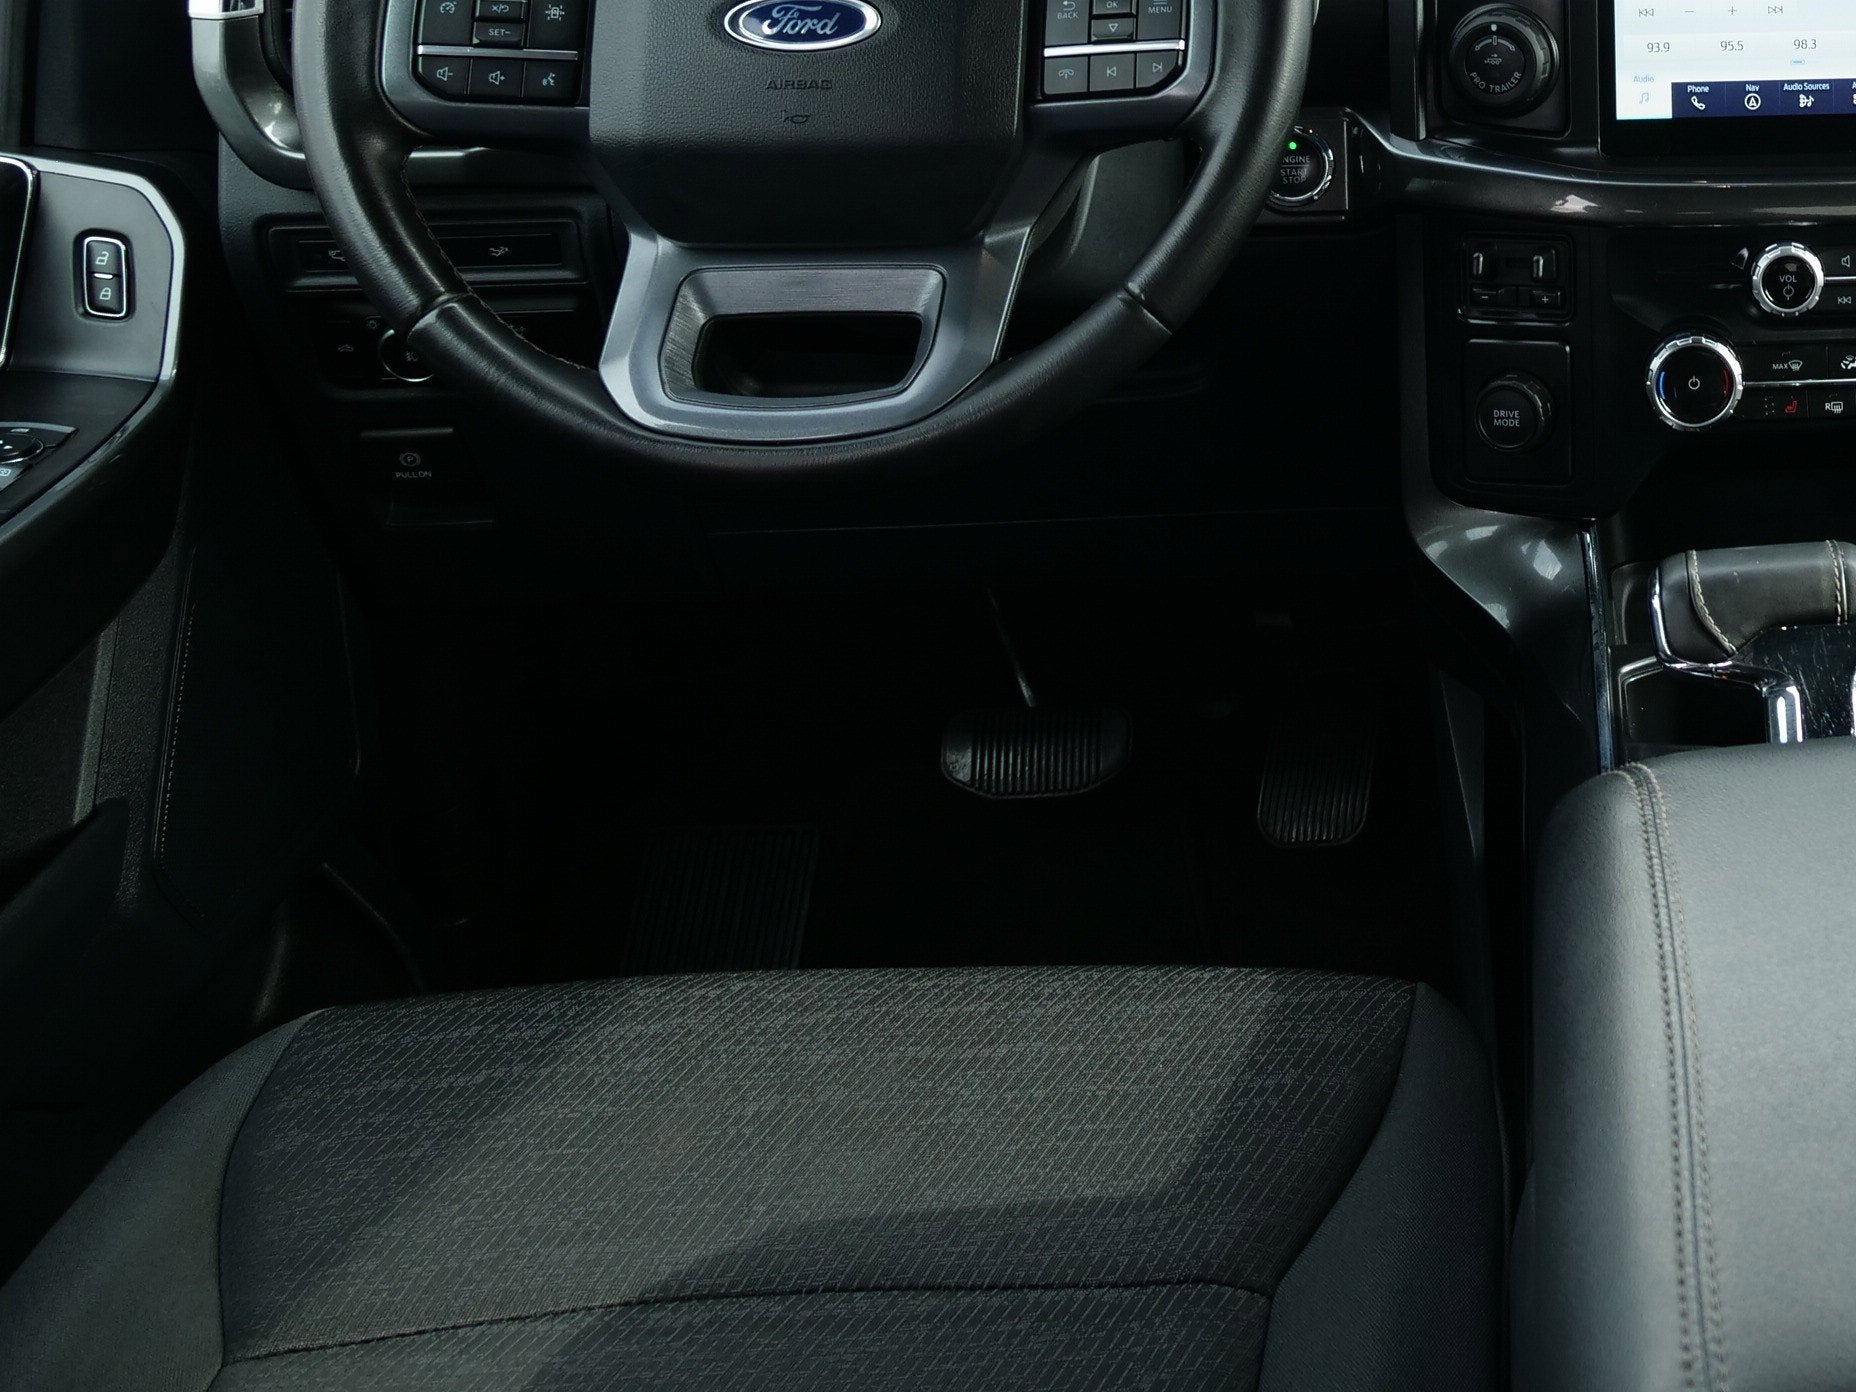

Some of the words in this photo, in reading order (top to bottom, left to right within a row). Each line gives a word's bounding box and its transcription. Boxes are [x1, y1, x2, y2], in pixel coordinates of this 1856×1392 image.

[1106, 0, 1118, 9] OK
[1148, 6, 1172, 14] MENU
[761, 4, 841, 35] Ford
[1057, 11, 1079, 20] BACK
[1646, 42, 1671, 53] 93.9
[1720, 41, 1744, 52] 95.5
[1793, 39, 1817, 50] 98.3
[1633, 75, 1655, 83] Audio
[765, 79, 833, 90] AIRBAG
[1687, 85, 1710, 93] Phone
[1745, 84, 1760, 92] Nav
[1783, 82, 1802, 91] Audio
[1803, 82, 1830, 91] Sources
[1282, 155, 1312, 164] NGINE
[1281, 169, 1308, 177] START
[1283, 176, 1306, 184] STOP
[1779, 275, 1798, 283] VOL
[1493, 409, 1520, 418] DRIVE
[1493, 418, 1520, 427] MODE
[418, 470, 432, 478] ON
